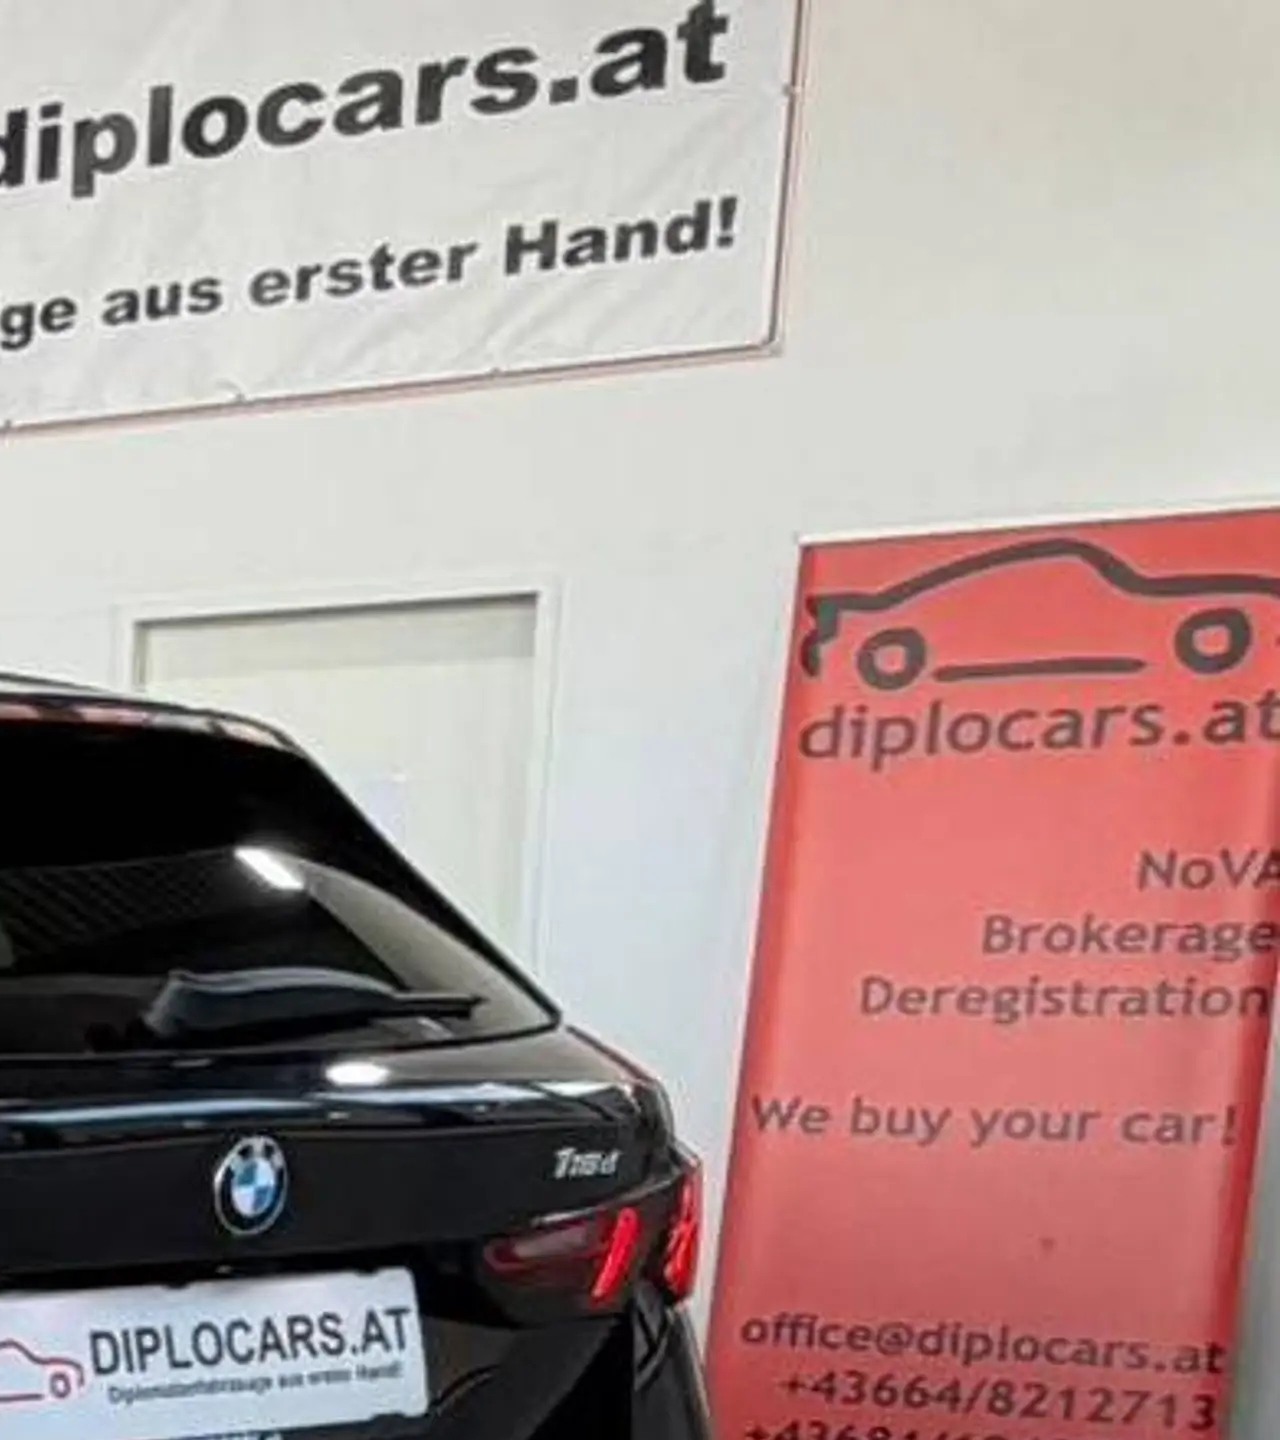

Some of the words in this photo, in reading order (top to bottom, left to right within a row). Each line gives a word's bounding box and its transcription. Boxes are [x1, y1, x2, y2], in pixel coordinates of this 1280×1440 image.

[101, 275, 222, 326] aus
[248, 240, 477, 306] erster
[504, 195, 739, 275] Hand!
[798, 690, 1280, 772] diplocars.at
[982, 912, 1280, 962] Brokerage
[860, 975, 1270, 1026] Deregistration
[752, 1094, 831, 1134] We
[851, 1097, 951, 1147] buy
[970, 1106, 1100, 1148] your
[1121, 1106, 1238, 1147] car!
[90, 1308, 411, 1376] DIPLOCARS.AT
[741, 1312, 1226, 1375] office@diplocars.at
[781, 1370, 1216, 1431] +43664/8212713
